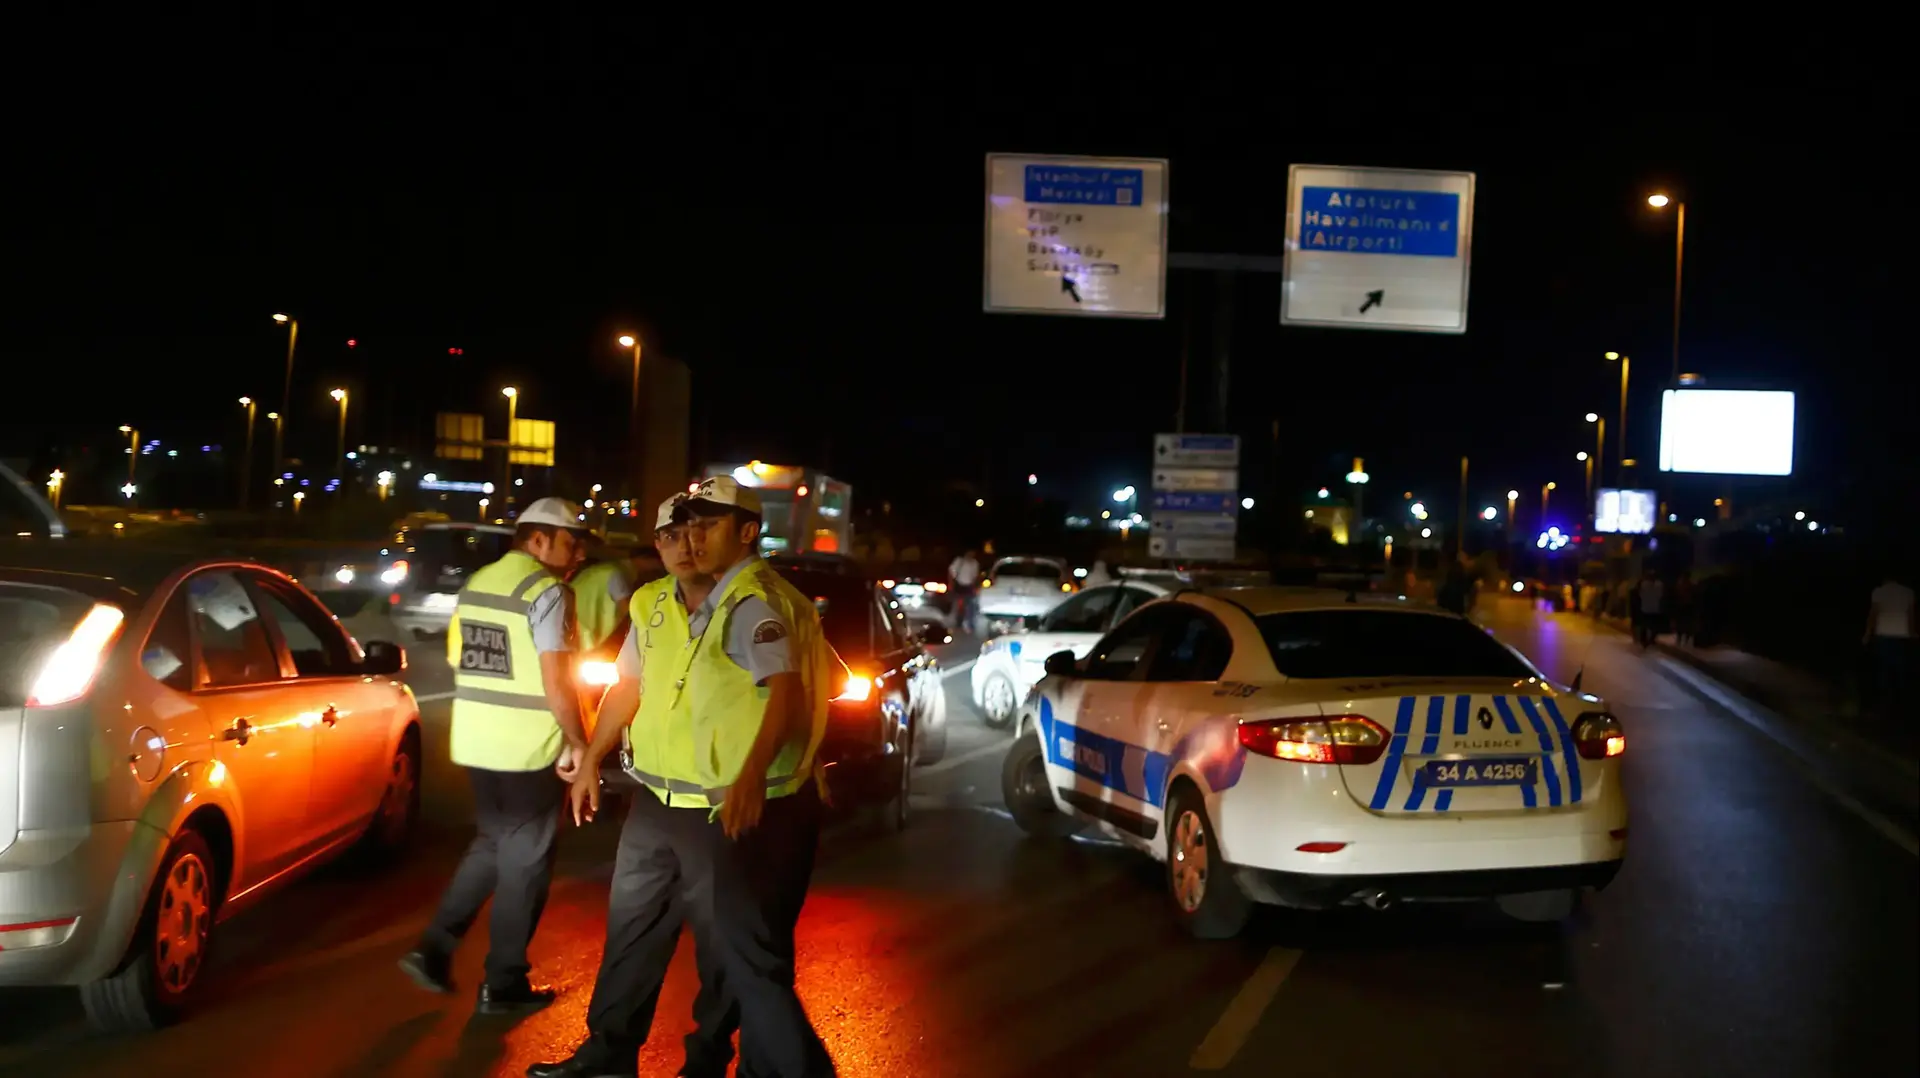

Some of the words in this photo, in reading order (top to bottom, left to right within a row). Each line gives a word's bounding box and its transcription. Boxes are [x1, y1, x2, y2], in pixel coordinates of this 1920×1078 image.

[1304, 230, 1403, 250] (Airport)
[1453, 739, 1524, 750] FLUENCE
[1436, 763, 1460, 781] 34
[1464, 764, 1479, 781] A
[1482, 763, 1526, 780] 4256
